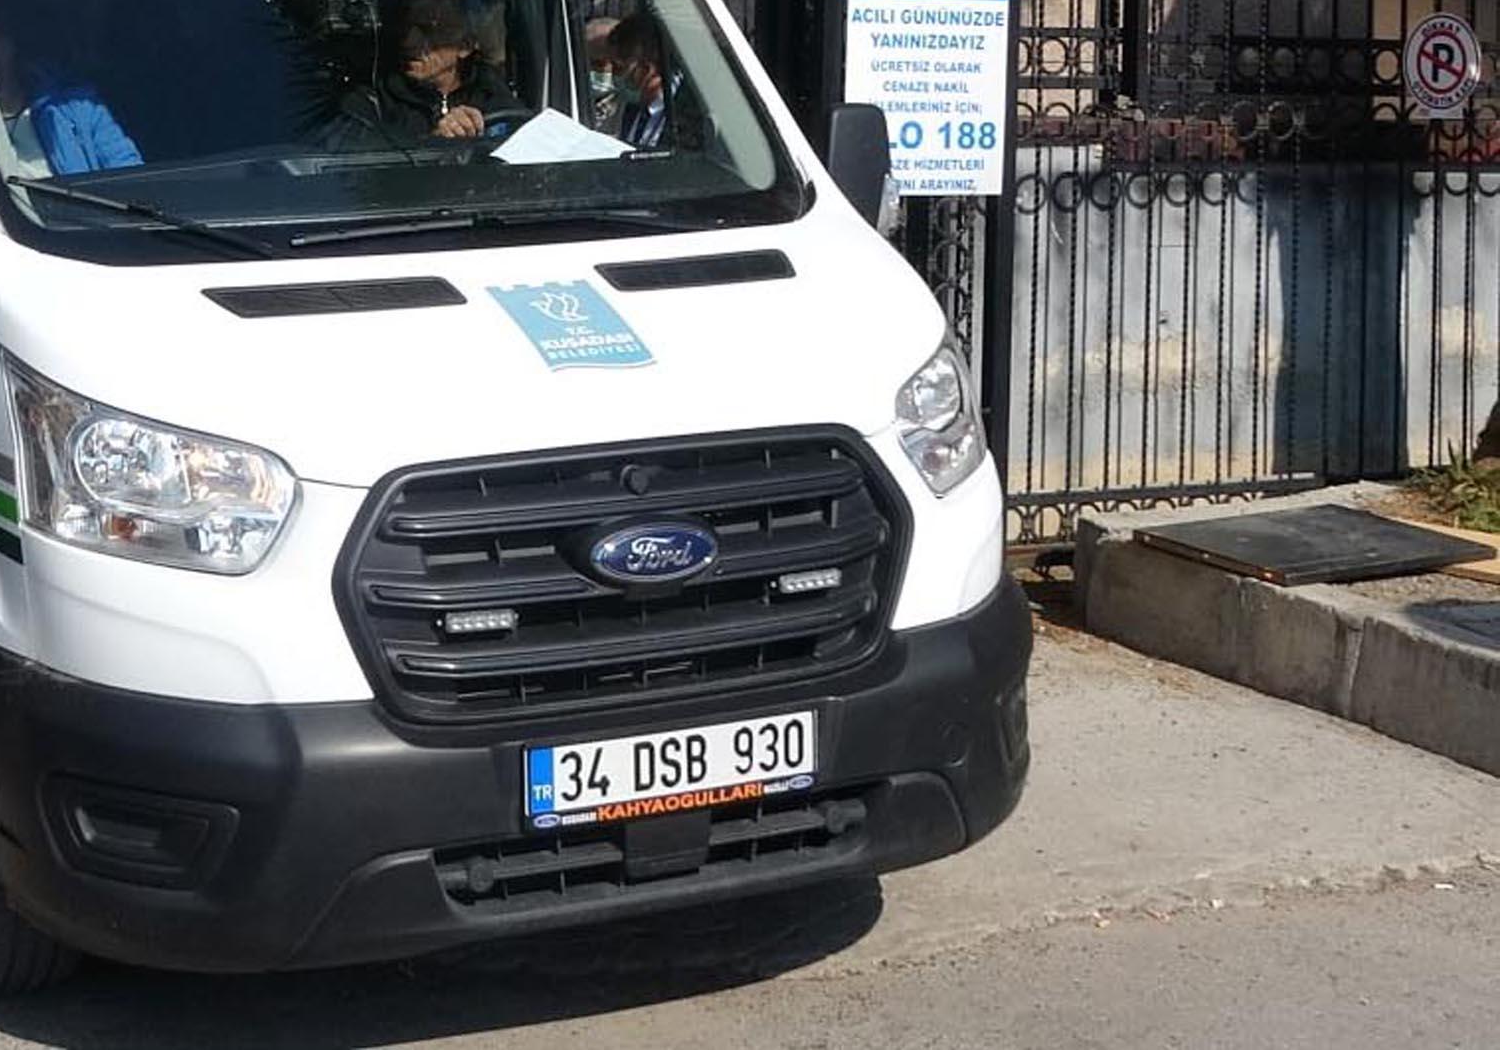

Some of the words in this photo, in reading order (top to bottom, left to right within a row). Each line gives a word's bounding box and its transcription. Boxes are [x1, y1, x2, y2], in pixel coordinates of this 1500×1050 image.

[852, 8, 895, 24] ACILI
[901, 6, 1004, 26] GÜNÜNÜZDE
[871, 33, 985, 49] YANINIZDAYIZ
[934, 61, 981, 73] OLARAK
[883, 80, 929, 92] CENAZE
[938, 121, 996, 149] 188
[626, 536, 693, 570] Ford
[533, 784, 552, 801] TR
[560, 747, 610, 801] 34
[634, 734, 707, 791] DSB
[733, 719, 804, 775] 930
